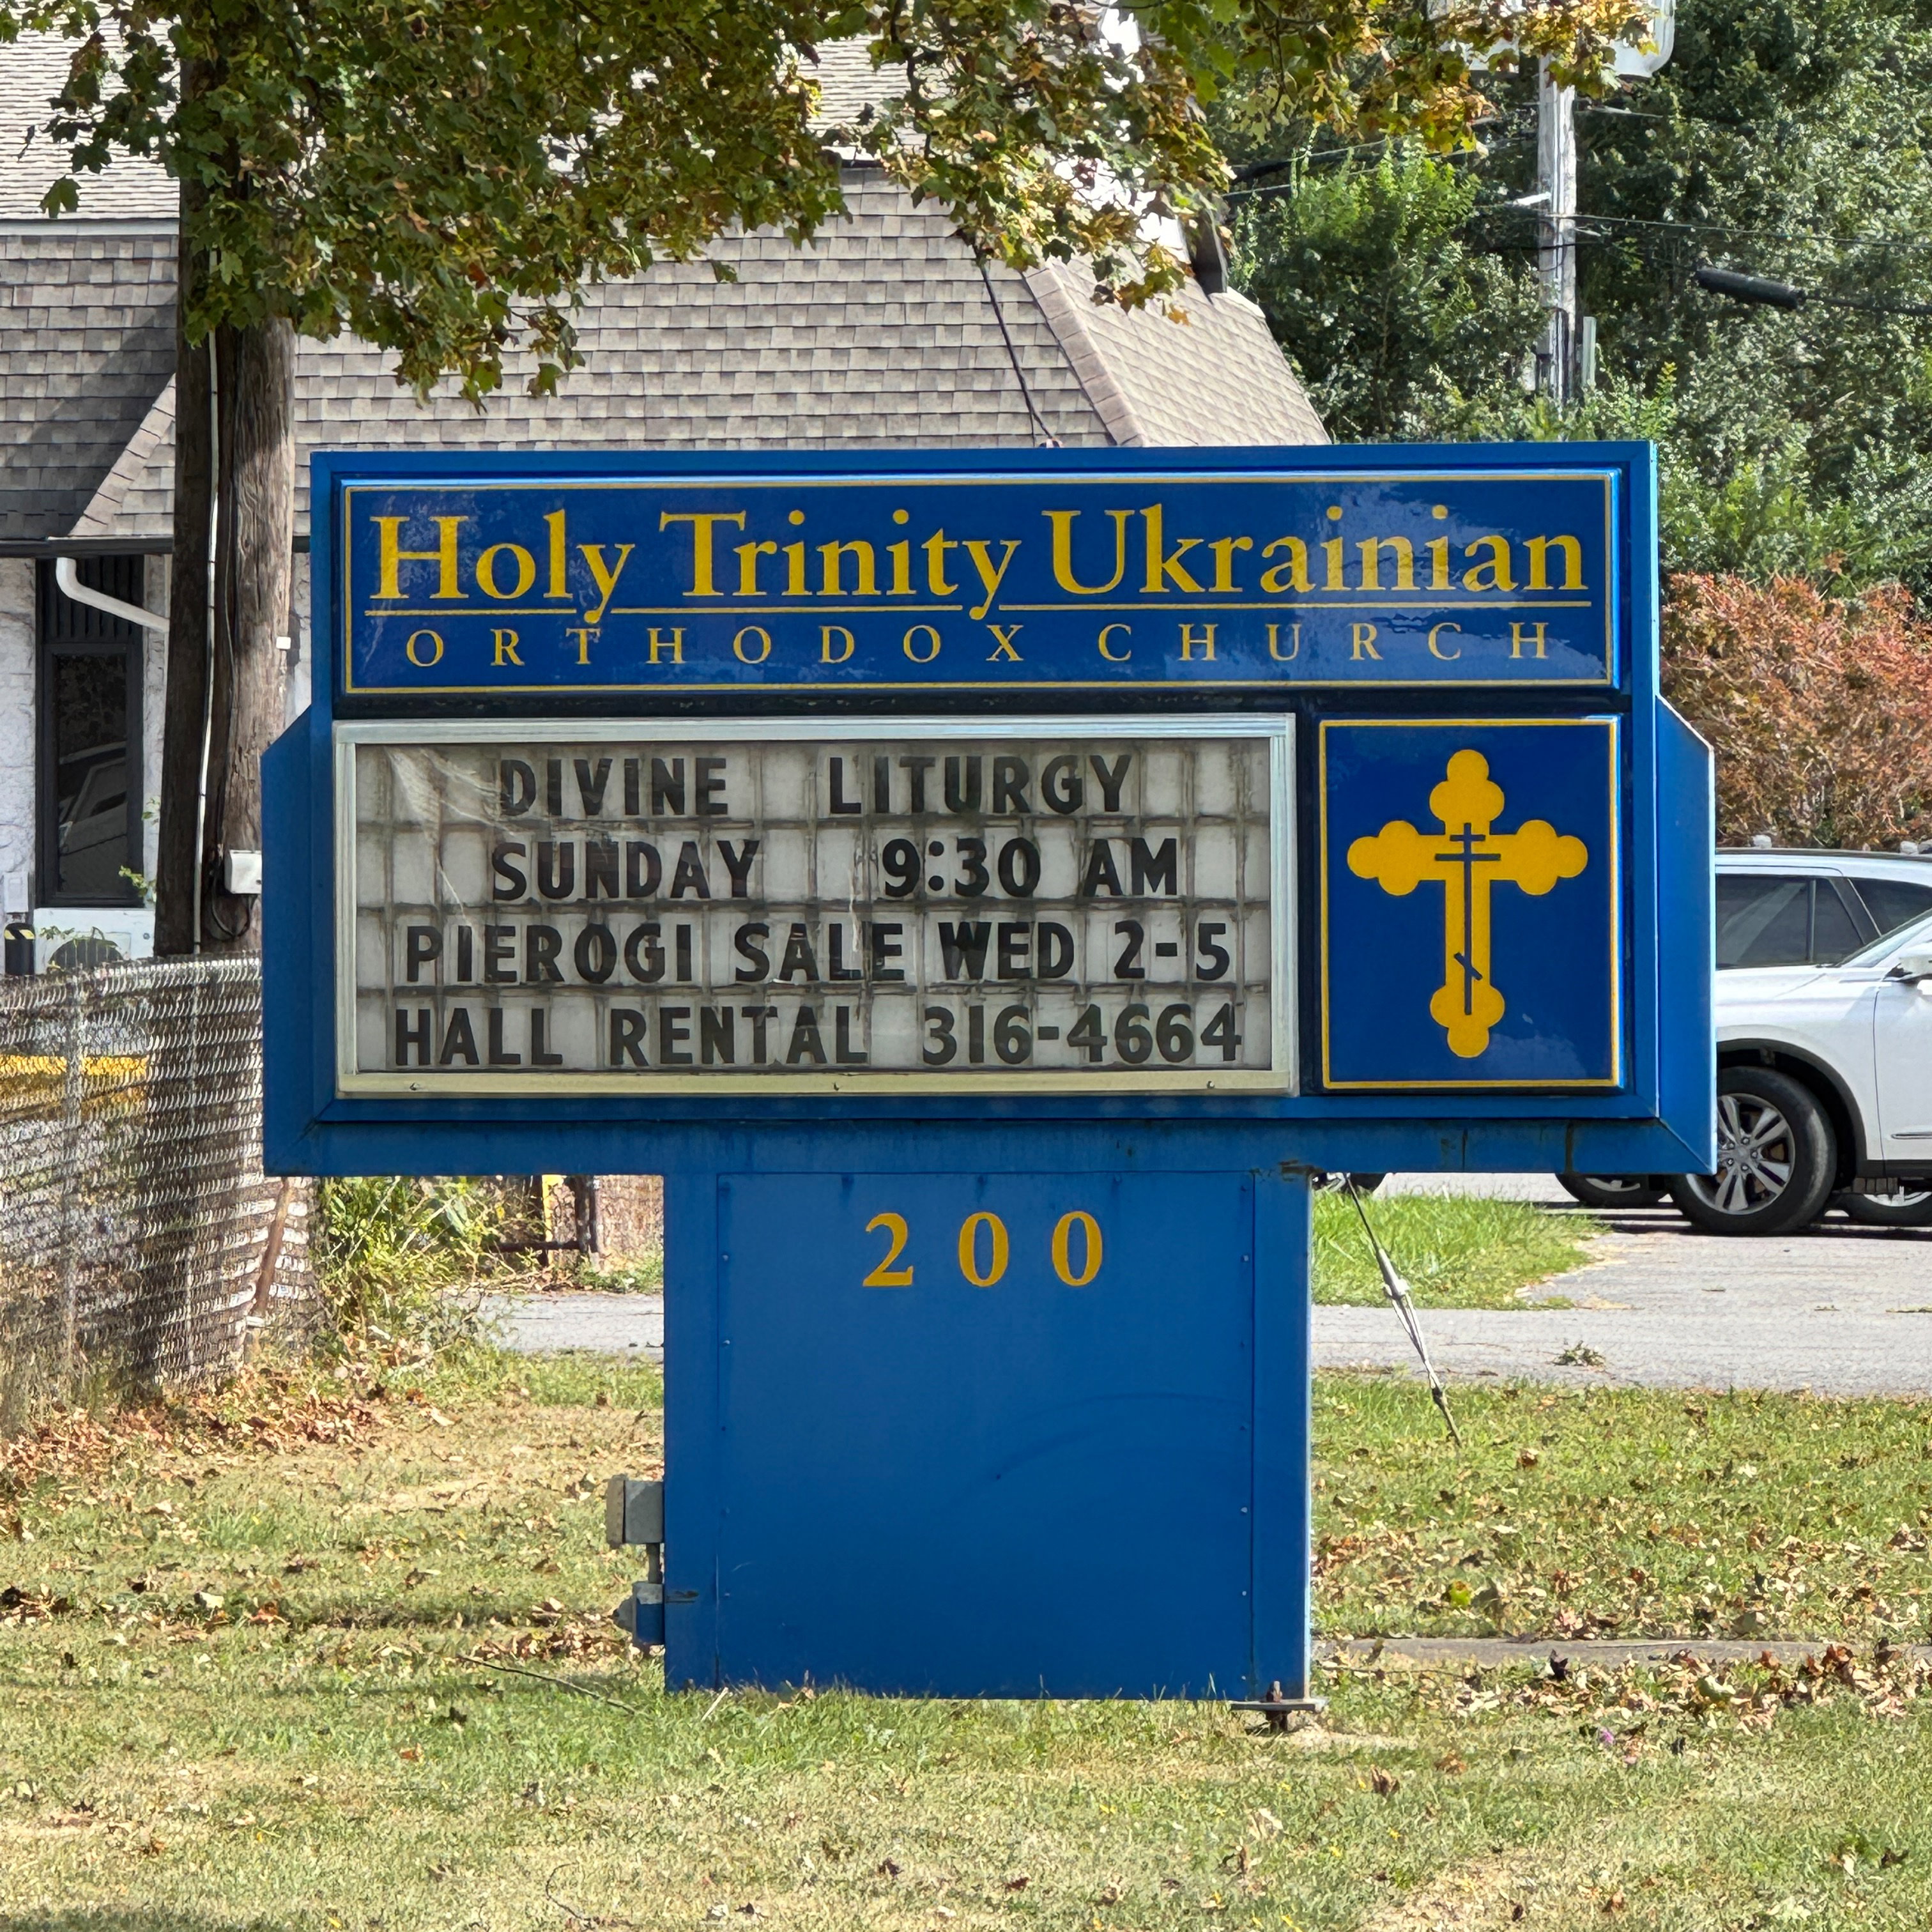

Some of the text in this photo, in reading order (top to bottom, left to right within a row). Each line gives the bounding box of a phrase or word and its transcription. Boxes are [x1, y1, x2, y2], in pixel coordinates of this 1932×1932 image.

[369, 503, 1588, 624] Holy Trinity Ukrainian
[406, 622, 1549, 667] ORTHODOX CHURCH
[500, 755, 1131, 816] DIVINE LITURGY
[491, 838, 1177, 900] SUNDAY 9:30 AM
[406, 921, 1230, 983] PIEROGI SALE WED 2-5
[395, 1004, 1241, 1066] HALL RENTAL 316-4664
[862, 1211, 1103, 1287] 200
